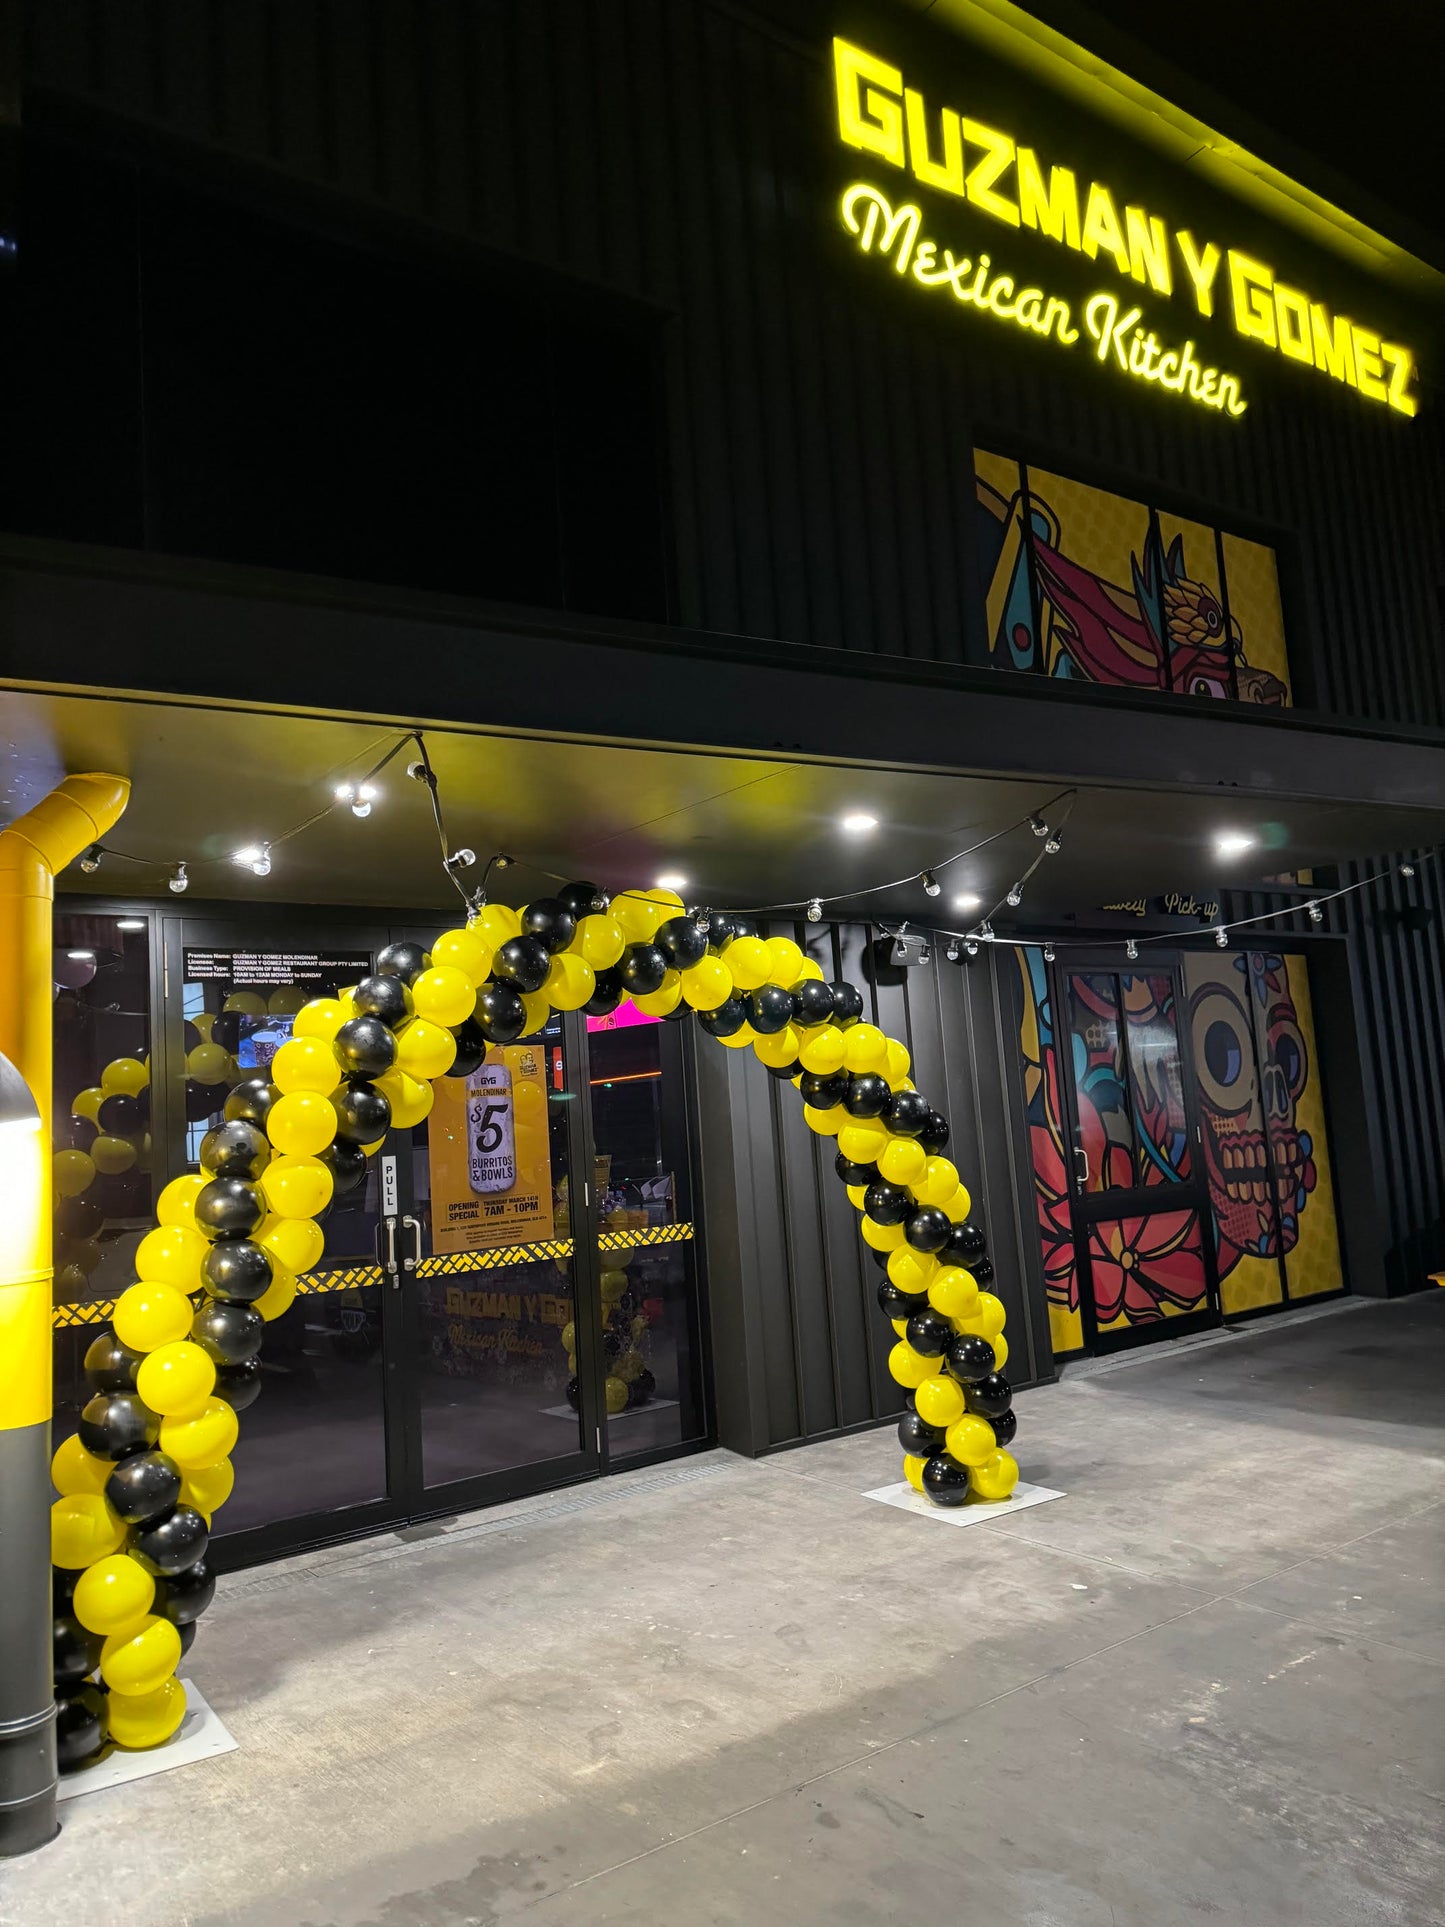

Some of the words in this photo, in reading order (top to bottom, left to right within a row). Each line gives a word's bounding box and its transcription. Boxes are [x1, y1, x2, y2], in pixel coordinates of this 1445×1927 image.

[833, 36, 1172, 297] GUZMAN
[1176, 230, 1221, 317] Y
[1228, 249, 1416, 418] GOMEZ
[841, 184, 1078, 345] Mexican
[1086, 293, 1247, 416] Kitchen
[1164, 893, 1219, 922] Pick-up
[480, 1076, 497, 1085] GYG
[470, 1088, 507, 1098] MOLENDINAR
[472, 1155, 513, 1169] BURRITOS
[386, 1166, 394, 1206] PULL
[448, 1201, 480, 1212] OPENING
[484, 1205, 505, 1216] 7AM
[513, 1201, 539, 1213] 10PM
[448, 1210, 480, 1221] SPECIAL
